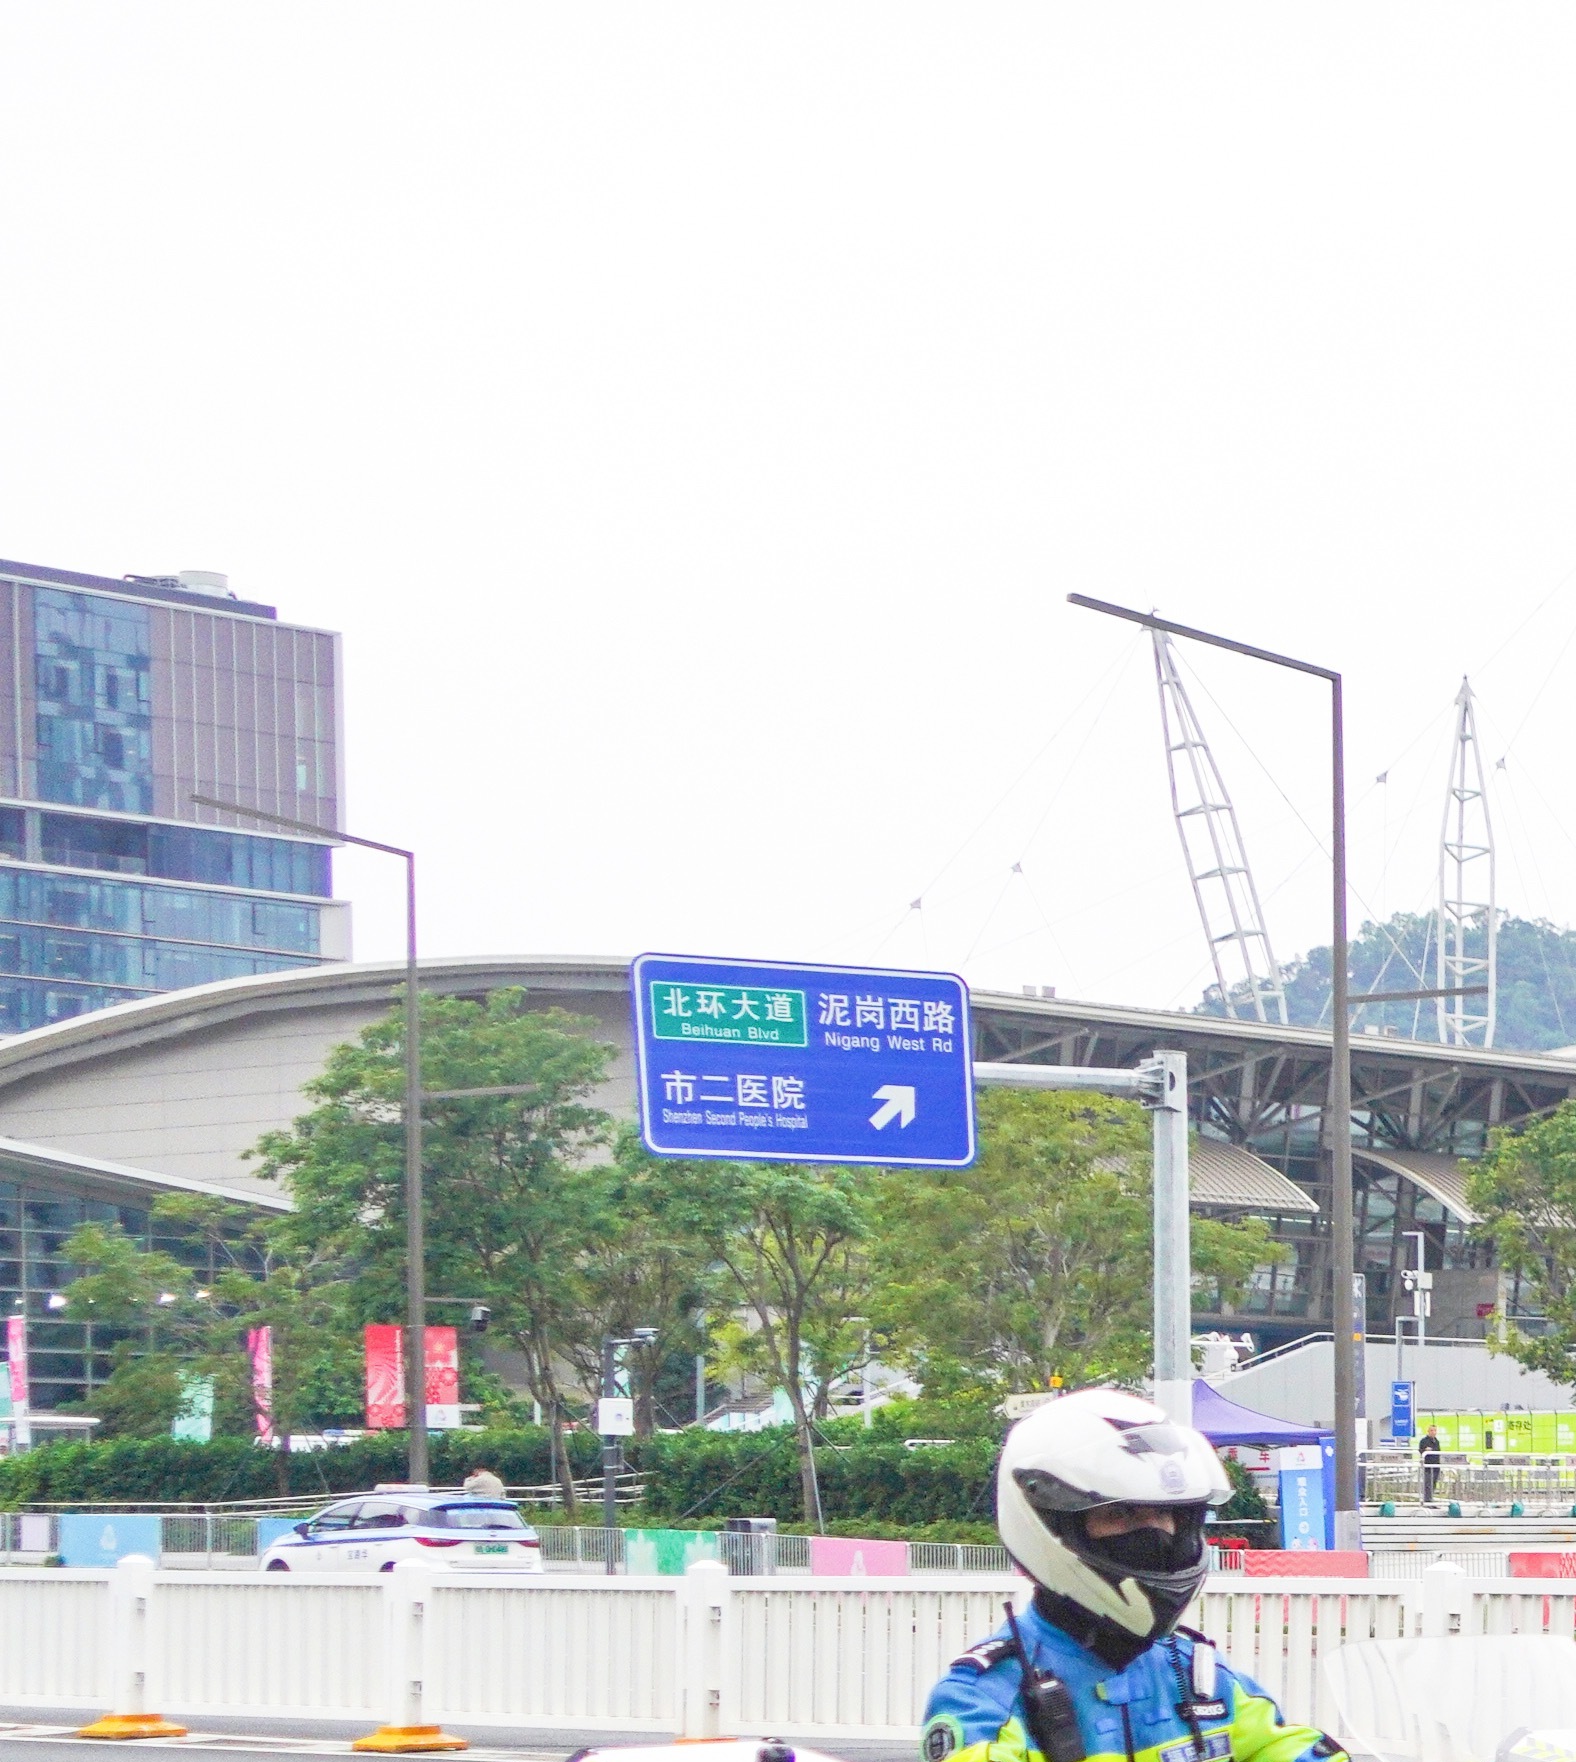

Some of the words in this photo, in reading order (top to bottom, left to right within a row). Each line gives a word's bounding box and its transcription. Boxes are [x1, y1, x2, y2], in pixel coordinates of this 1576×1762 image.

[663, 988, 794, 1023] 北环大道
[818, 992, 956, 1034] 泥岗西路
[681, 1023, 740, 1039] Beihuan
[748, 1026, 780, 1041] Blvd
[825, 1032, 880, 1052] Nigang
[887, 1036, 925, 1051] West
[932, 1038, 953, 1053] Rd
[661, 1070, 806, 1109] 市二医院
[662, 1108, 703, 1125] Shenzhen
[705, 1110, 736, 1126] Second
[739, 1111, 773, 1129] People's
[776, 1112, 809, 1129] Hospital
